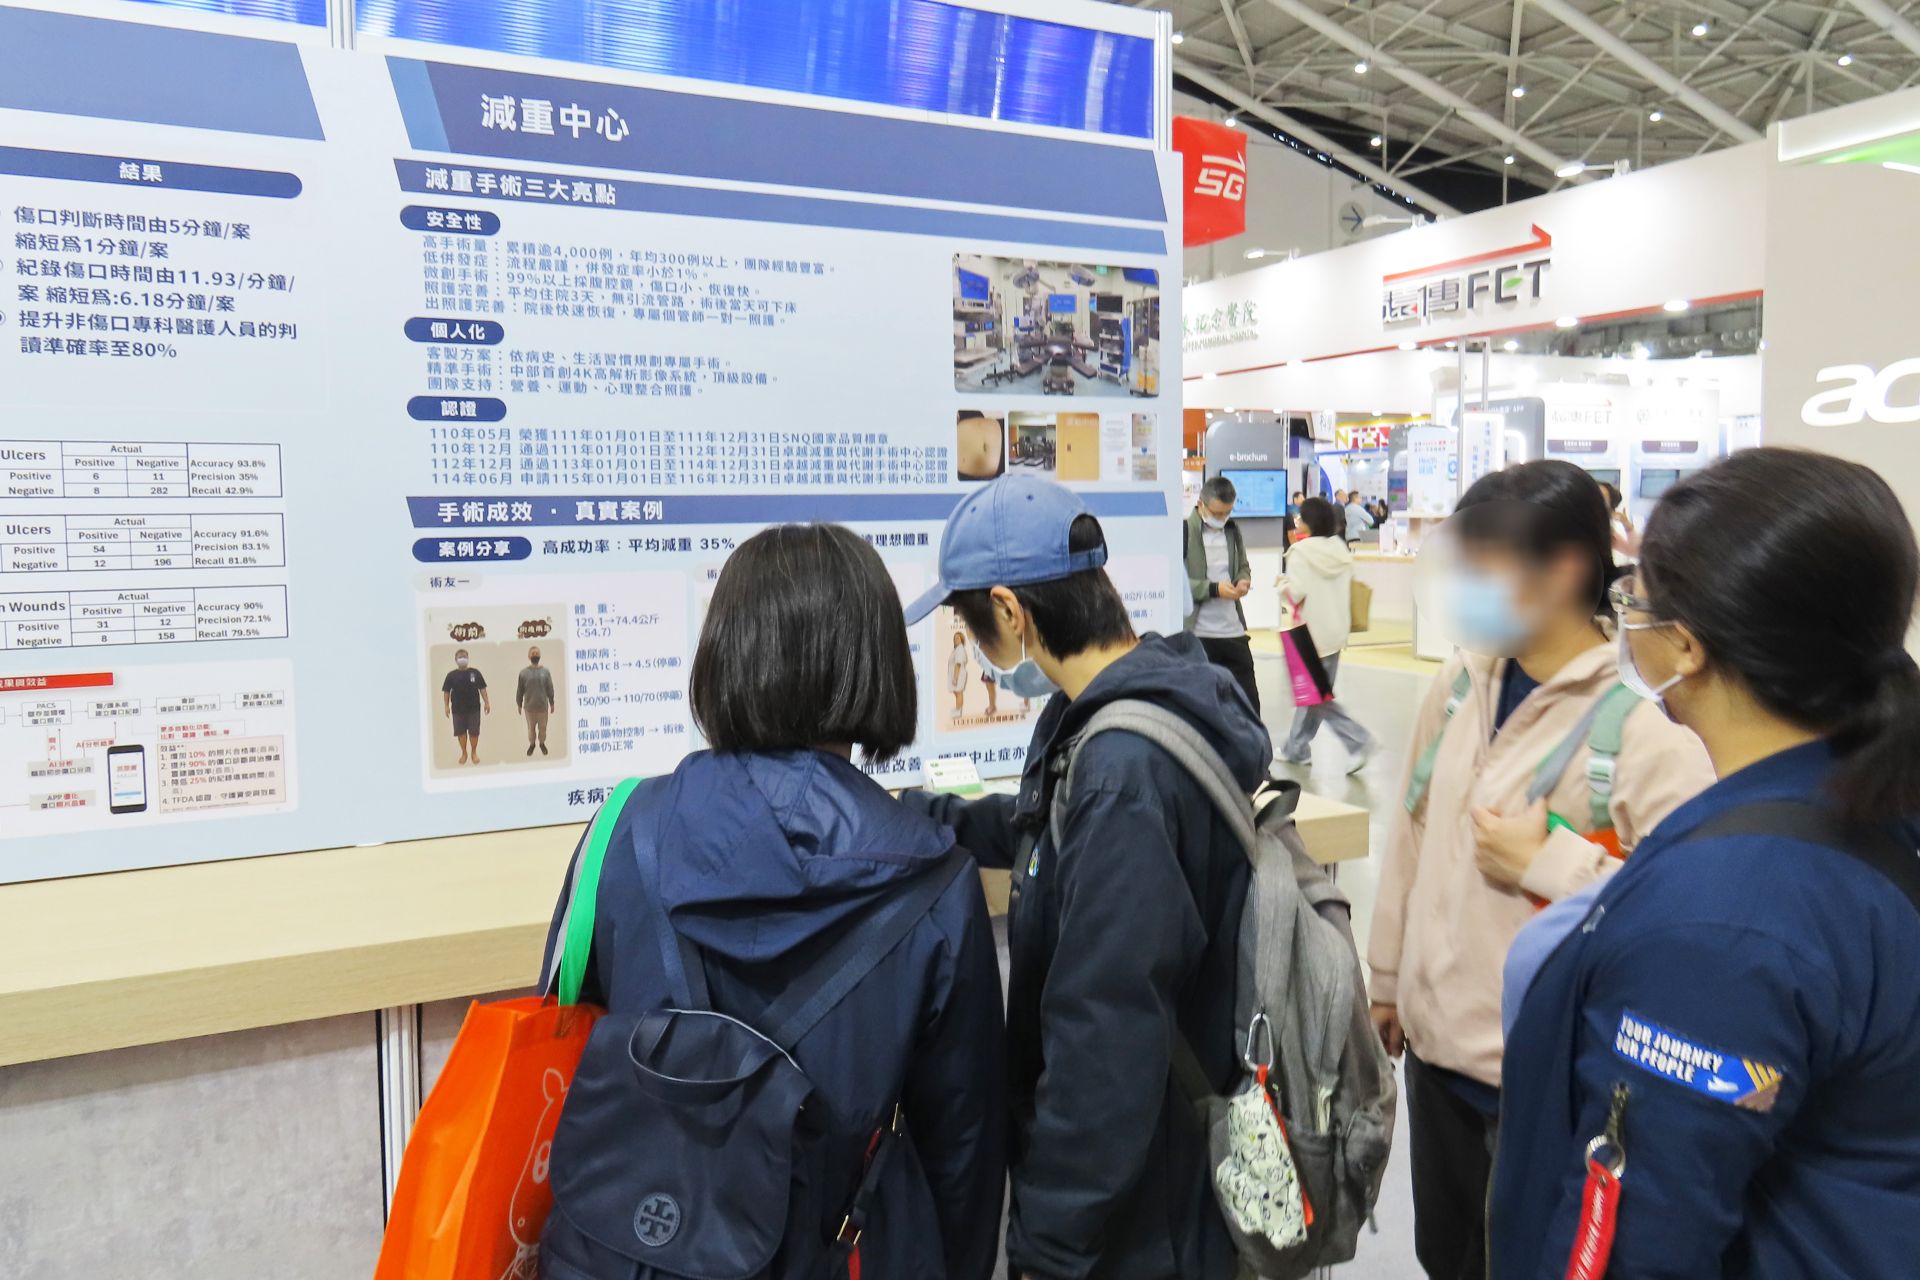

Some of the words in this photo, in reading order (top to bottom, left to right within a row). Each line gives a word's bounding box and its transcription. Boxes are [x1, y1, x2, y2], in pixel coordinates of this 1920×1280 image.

[481, 93, 630, 142] 減重中心
[119, 161, 163, 183] 結果
[425, 167, 616, 205] 減重手術三大亮點
[1194, 168, 1245, 201] 5G
[14, 206, 252, 240] 傷口判斷時間由5分鐘/案
[426, 210, 482, 231] 安全性
[16, 257, 295, 293] 紀錄傷口時間由11.93/分鐘/
[18, 284, 40, 303] 案
[19, 309, 298, 340] 提升非傷口專科醫護人員的判
[430, 322, 486, 340] 個人化
[20, 335, 178, 359] 讀準確率至80%
[441, 400, 477, 418] 認證
[430, 427, 511, 440] 110年05月
[1, 448, 46, 462] Ulcers
[110, 444, 143, 454] Actual
[431, 442, 511, 456] 110年12月
[74, 458, 116, 468] Positive
[136, 458, 180, 469] Negative
[190, 459, 235, 470] Accuracy
[237, 459, 267, 469] 93.8%
[432, 457, 512, 471] 112年12月
[1229, 452, 1268, 463] e-brochure
[9, 472, 52, 482] Positive
[93, 472, 100, 481] 6
[153, 472, 165, 481] 11
[191, 472, 236, 482] Precision
[238, 472, 259, 482] 35%
[432, 472, 512, 485] 114年06月
[8, 486, 55, 497] Negative
[93, 486, 101, 495] 8
[150, 486, 169, 496] 282
[191, 486, 222, 496] Recall
[225, 486, 254, 496] 42.9%
[438, 501, 533, 524] 手術成效
[576, 500, 663, 521] 真實案例
[6, 524, 52, 536] Ulcers
[114, 517, 146, 527] Actual
[78, 530, 119, 541] Positive
[140, 530, 183, 541] Negative
[193, 529, 238, 540] Accuracy
[14, 545, 56, 556] Positive
[93, 545, 106, 554] 54
[157, 544, 168, 553] 11
[194, 542, 239, 552] Precision
[439, 540, 510, 559] 案例分享
[543, 537, 692, 555] 高成功率：平均減重
[700, 538, 735, 551] 35%
[12, 559, 59, 571] Negative
[94, 559, 106, 568] 12
[154, 558, 172, 567] 196
[195, 556, 225, 566] Recall
[430, 576, 470, 588] 術友一
[9, 600, 66, 614] Wounds
[117, 592, 150, 601] Actual
[82, 606, 123, 616] Positive
[143, 604, 186, 615] Negative
[197, 602, 241, 614] Accuracy
[243, 601, 264, 611] 90%
[18, 622, 60, 632] Positive
[97, 620, 109, 629] 31
[160, 618, 172, 627] 12
[198, 615, 243, 626] Precision
[16, 636, 63, 648] Negative
[101, 634, 108, 643] 8
[158, 631, 176, 641] 158
[198, 629, 229, 639] Recall
[576, 626, 612, 639] (-54.7)
[576, 648, 617, 660] 糖尿病：
[663, 723, 685, 735] 術後
[579, 740, 634, 755] 停藥仍正常
[1653, 1031, 1724, 1074] JOURNEY
[1640, 1044, 1696, 1084] PEOPLE
